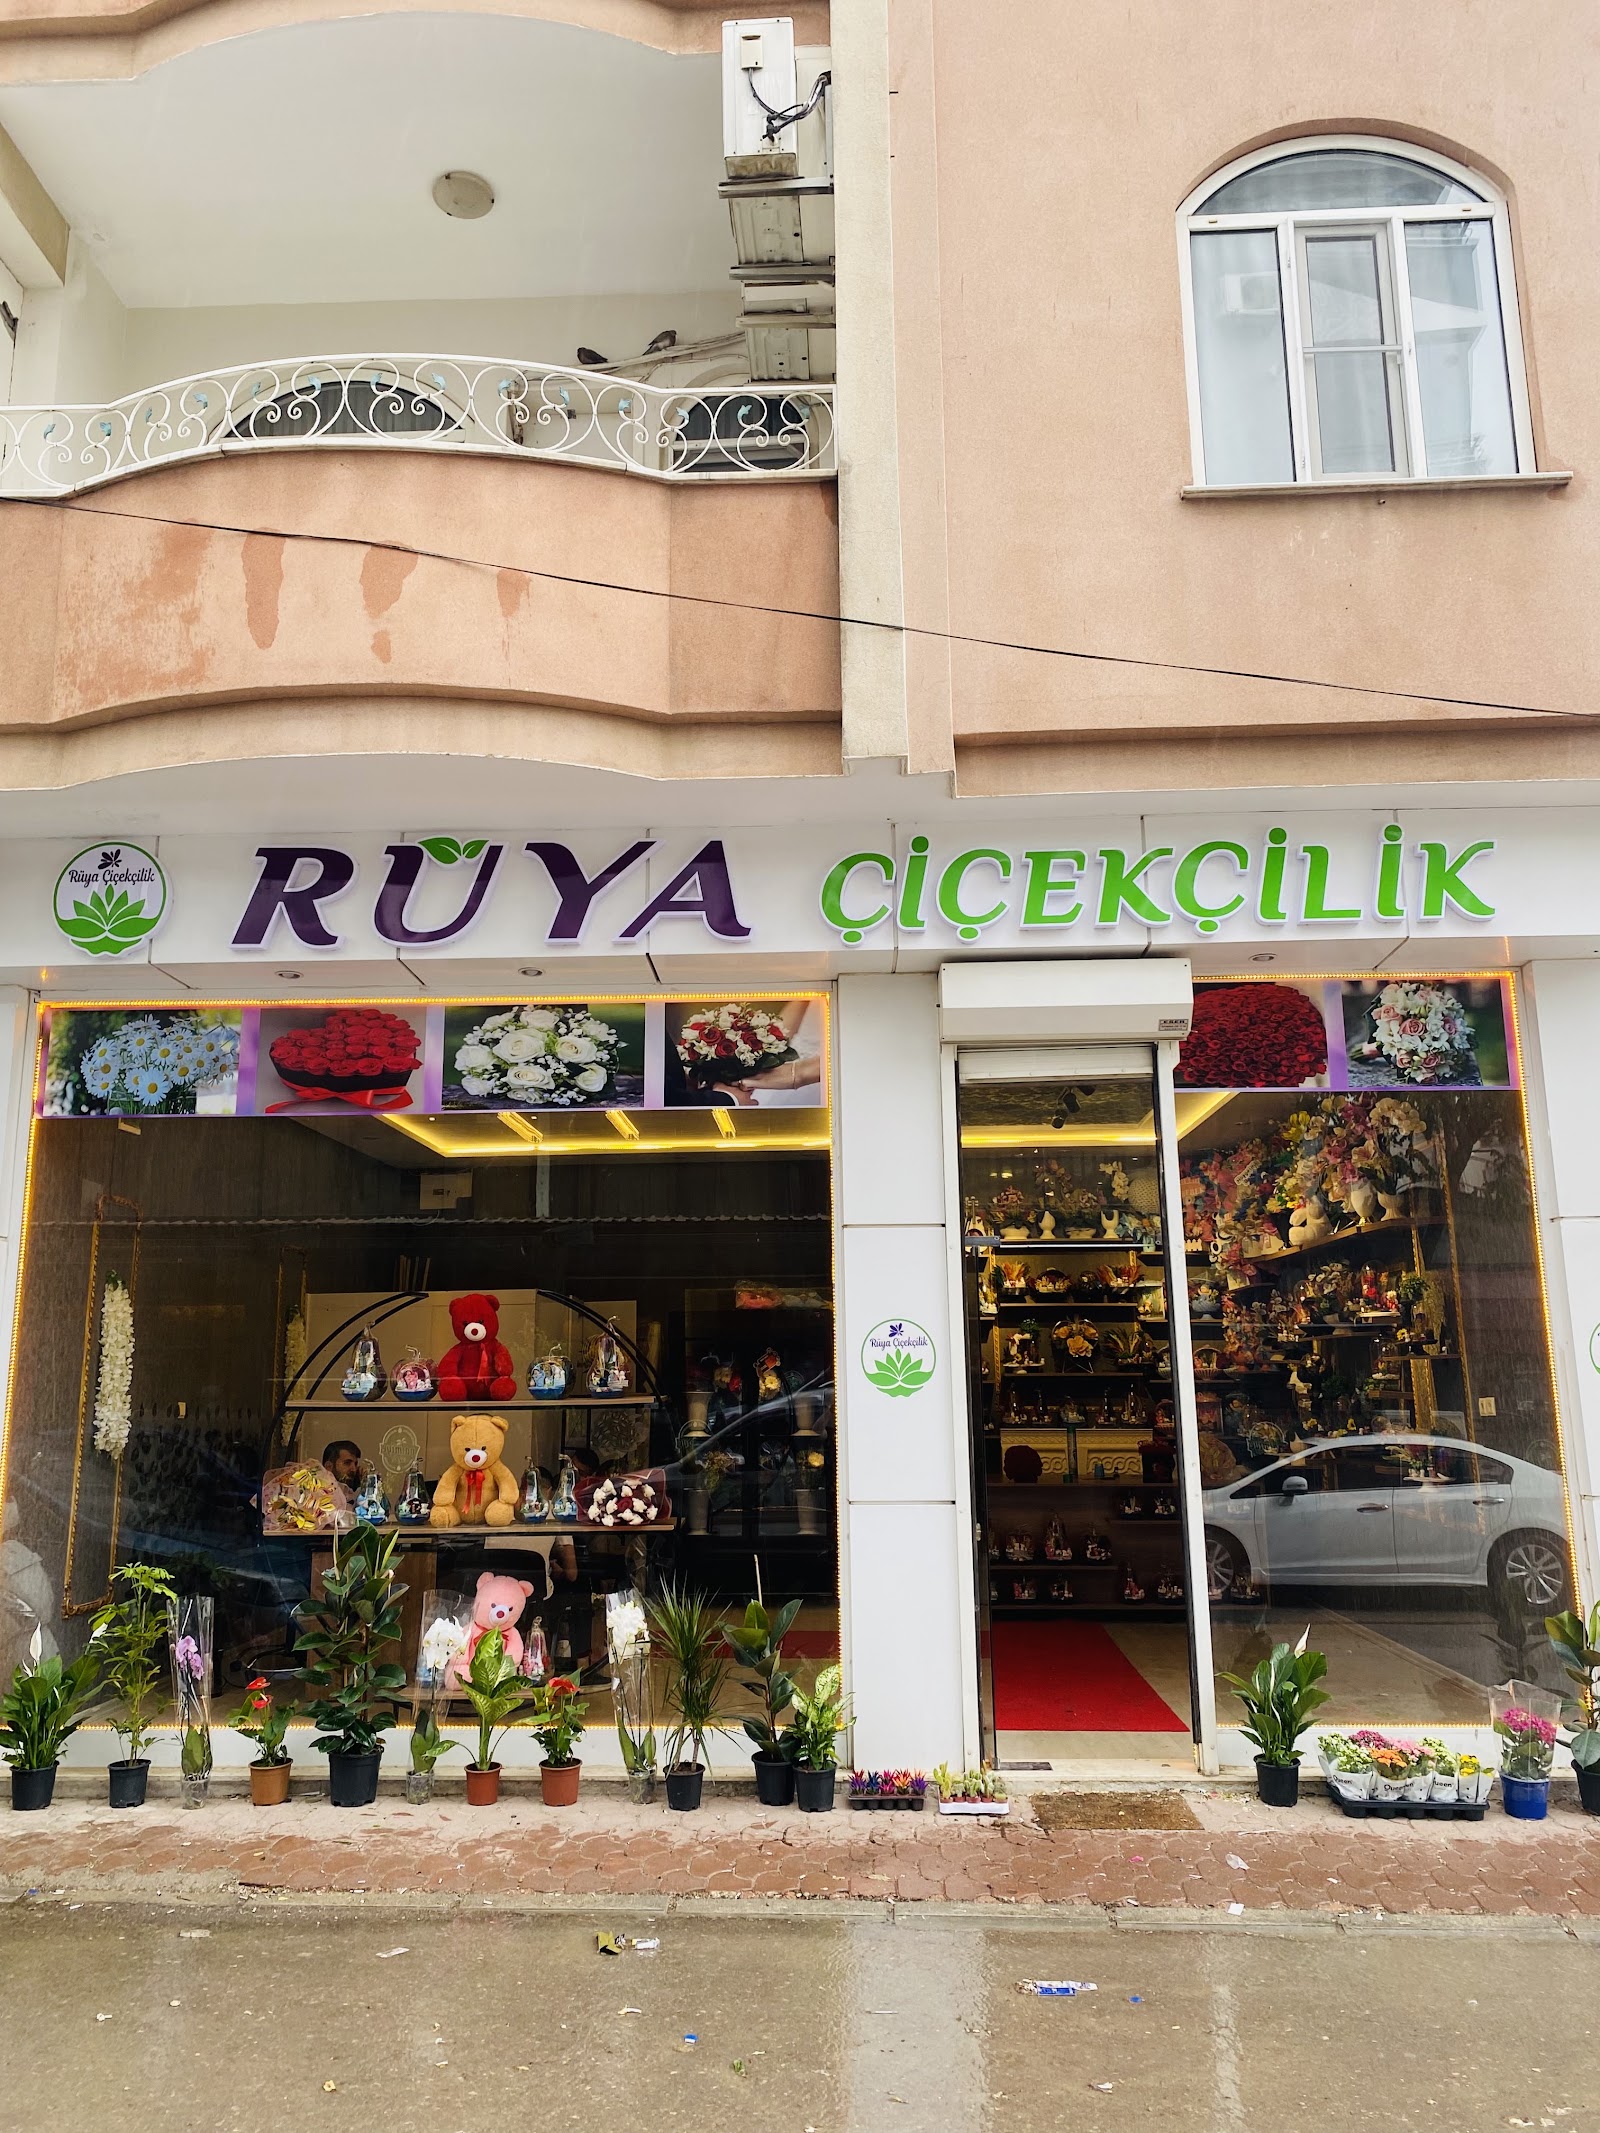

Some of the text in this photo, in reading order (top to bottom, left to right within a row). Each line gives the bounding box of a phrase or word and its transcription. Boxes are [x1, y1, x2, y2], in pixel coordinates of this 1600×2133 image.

[68, 867, 156, 888] Rüya Çiçekçilik
[820, 824, 1497, 945] ÇİÇEKÇİLİK
[869, 1336, 928, 1351] Rüya Çiçekçilik
